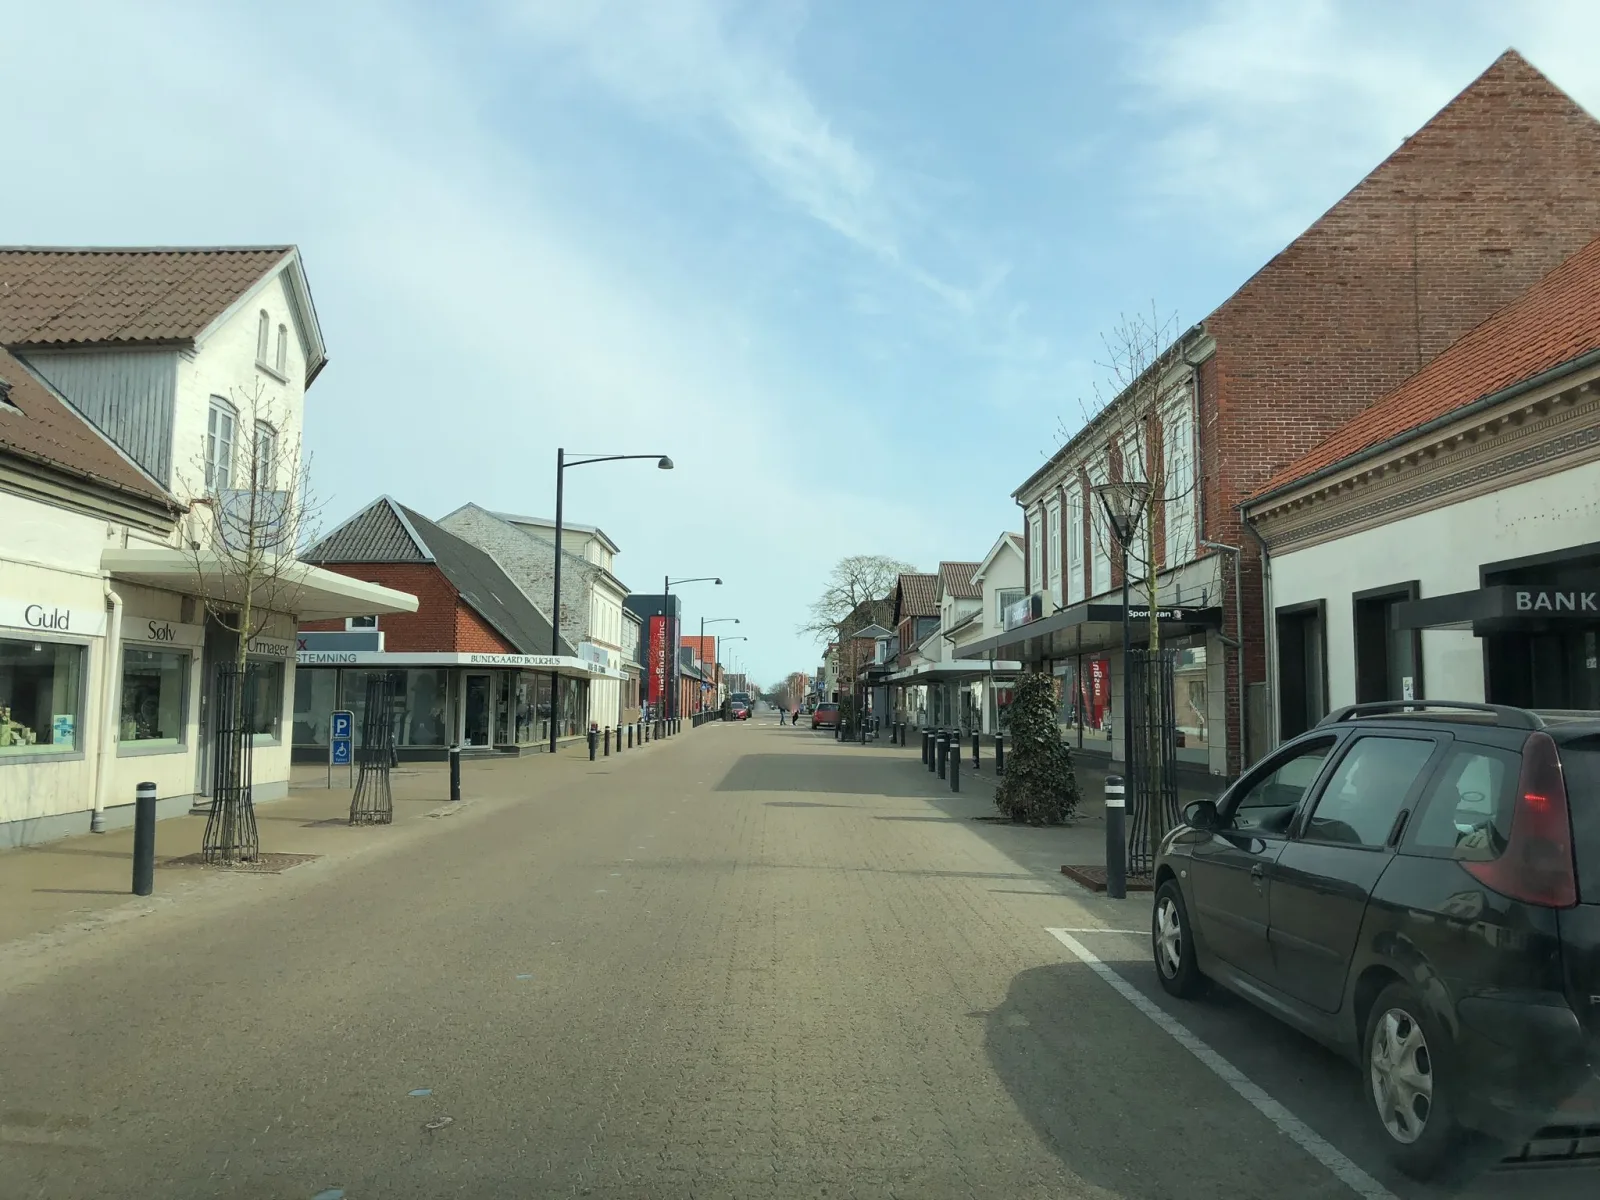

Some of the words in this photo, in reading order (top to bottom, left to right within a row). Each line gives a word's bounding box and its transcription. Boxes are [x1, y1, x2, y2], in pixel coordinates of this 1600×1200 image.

[1516, 591, 1599, 611] BANK
[24, 604, 70, 630] Guld
[147, 620, 177, 641] Sølv
[247, 637, 289, 657] Urmager
[470, 655, 523, 664] BUNDGAARD
[336, 719, 348, 733] P
